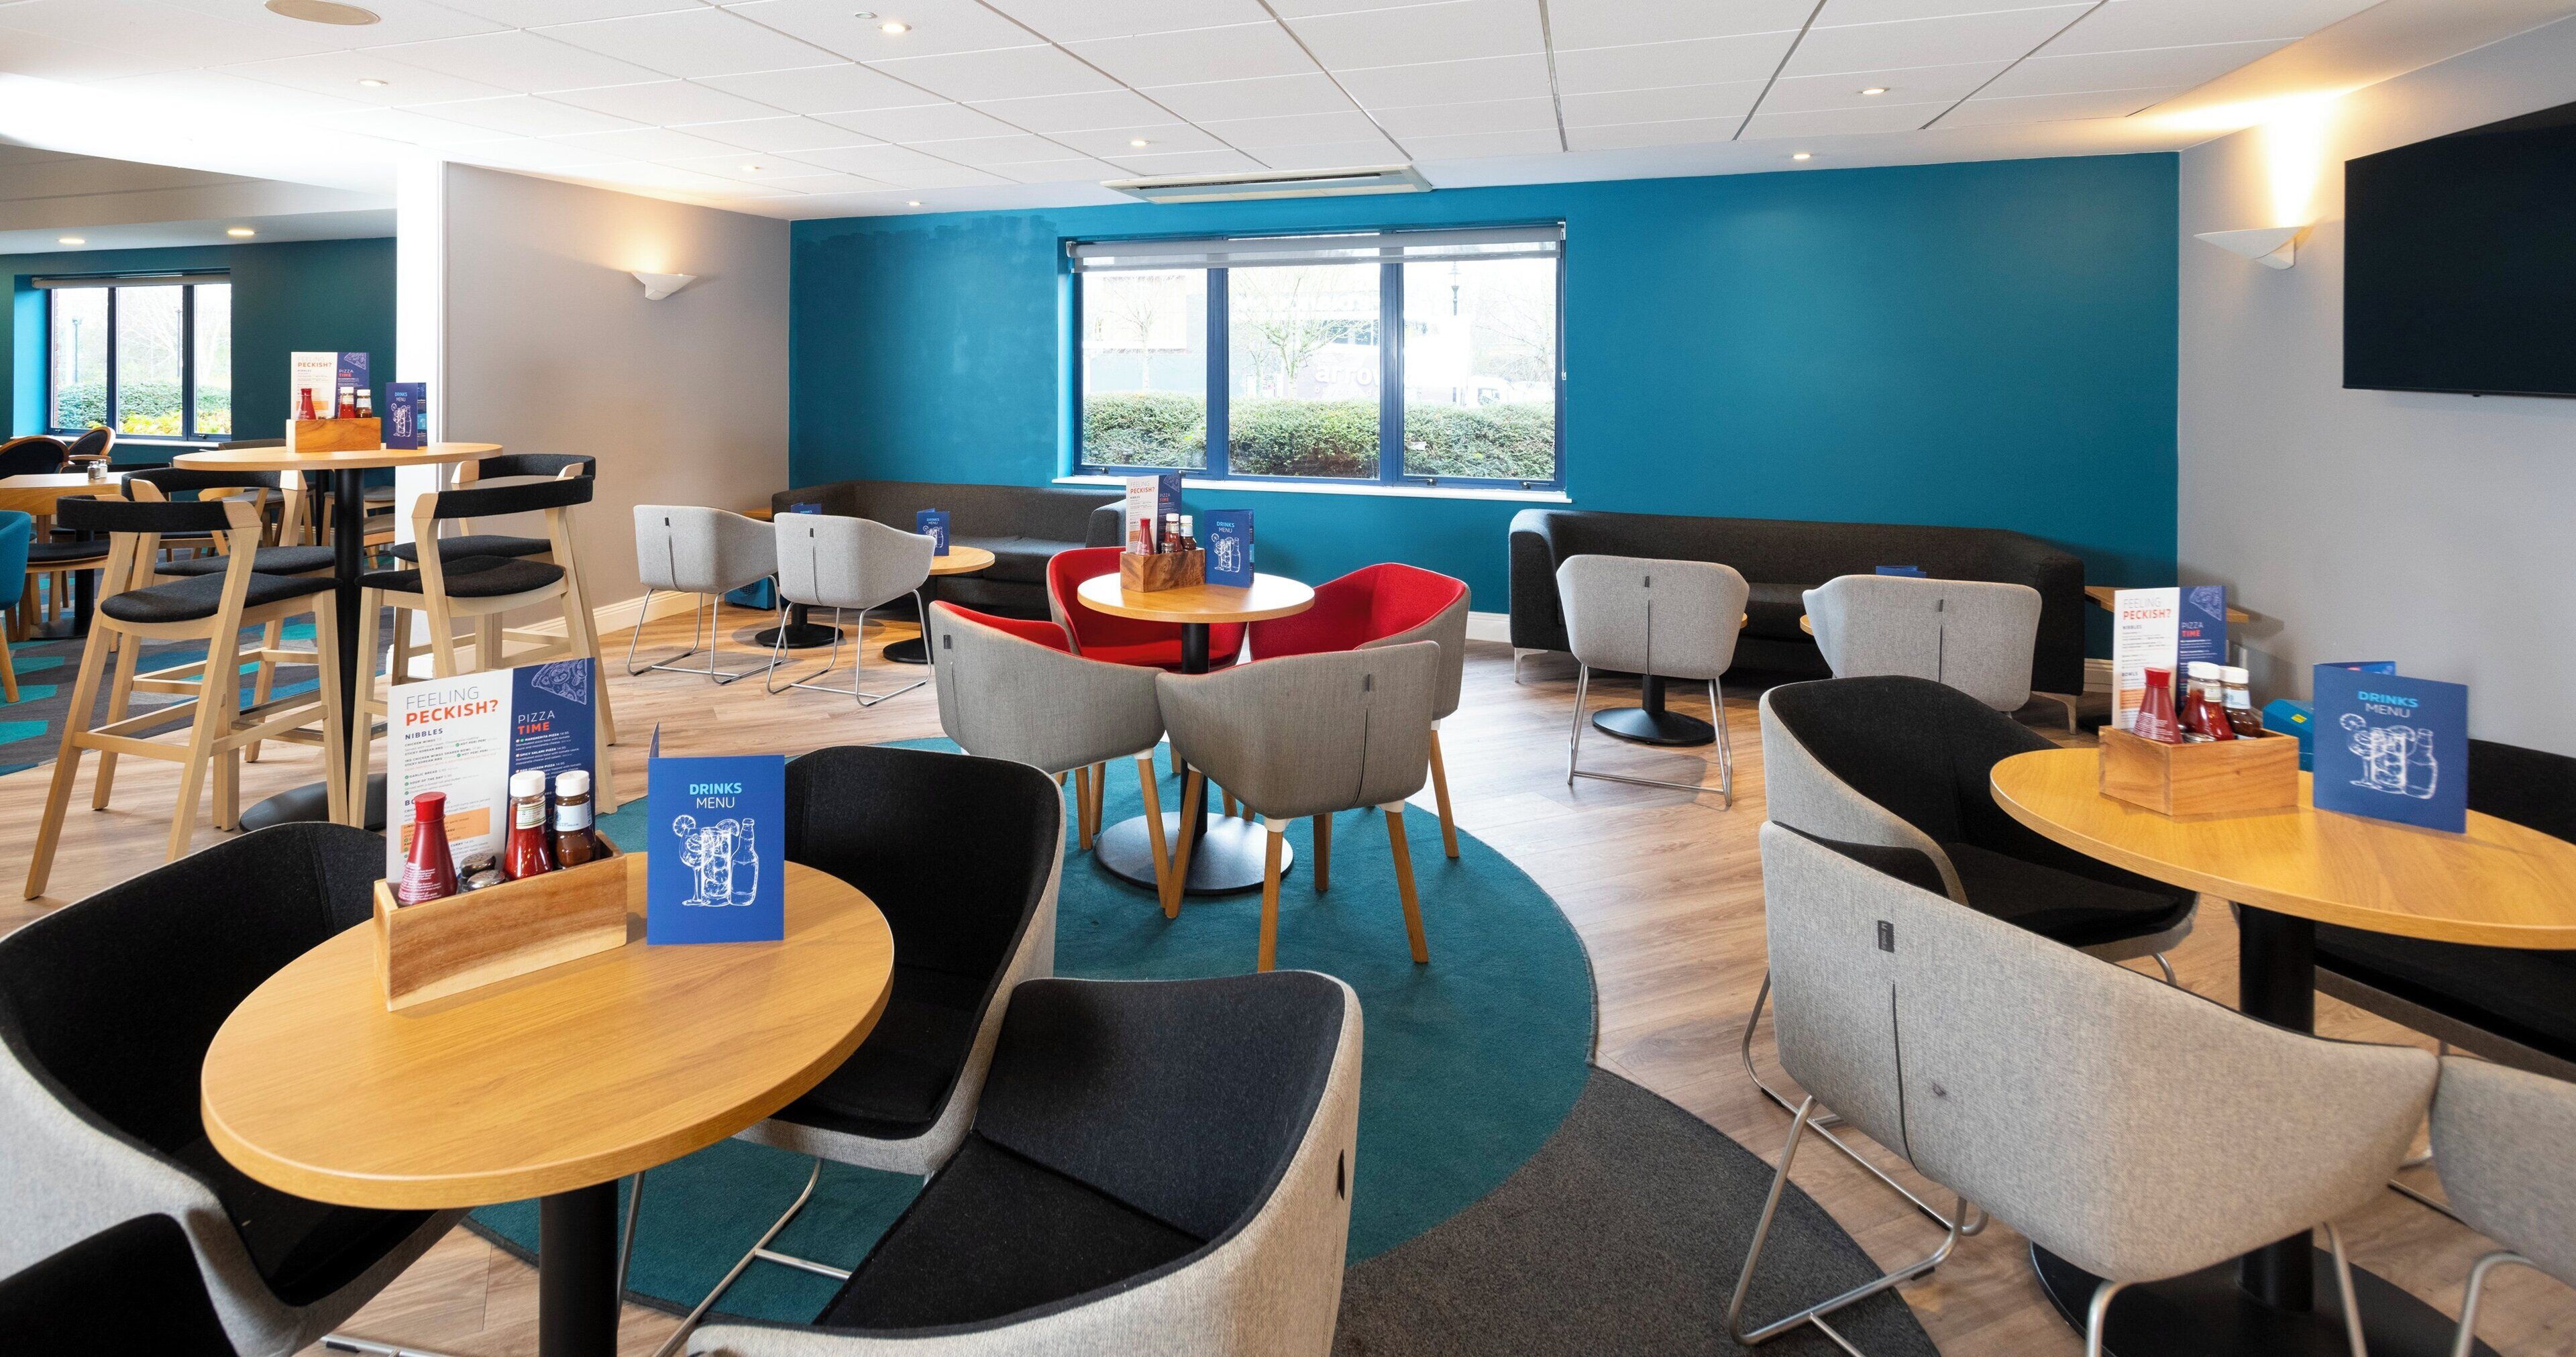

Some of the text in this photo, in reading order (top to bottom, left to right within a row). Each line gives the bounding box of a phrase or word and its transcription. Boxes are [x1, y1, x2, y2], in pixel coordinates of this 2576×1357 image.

[2123, 597, 2161, 608] FEELING
[2123, 608, 2171, 620] PECKISH?
[407, 686, 479, 710] FEELING
[2357, 690, 2419, 708] DRINKS
[406, 699, 498, 726] PECKISH?
[518, 710, 555, 724] PIZZA
[2365, 703, 2411, 718] MENU
[405, 728, 443, 740] NIBBLES
[517, 721, 550, 735] TIME
[689, 782, 743, 796] DRINKS
[696, 796, 735, 809] MENU
